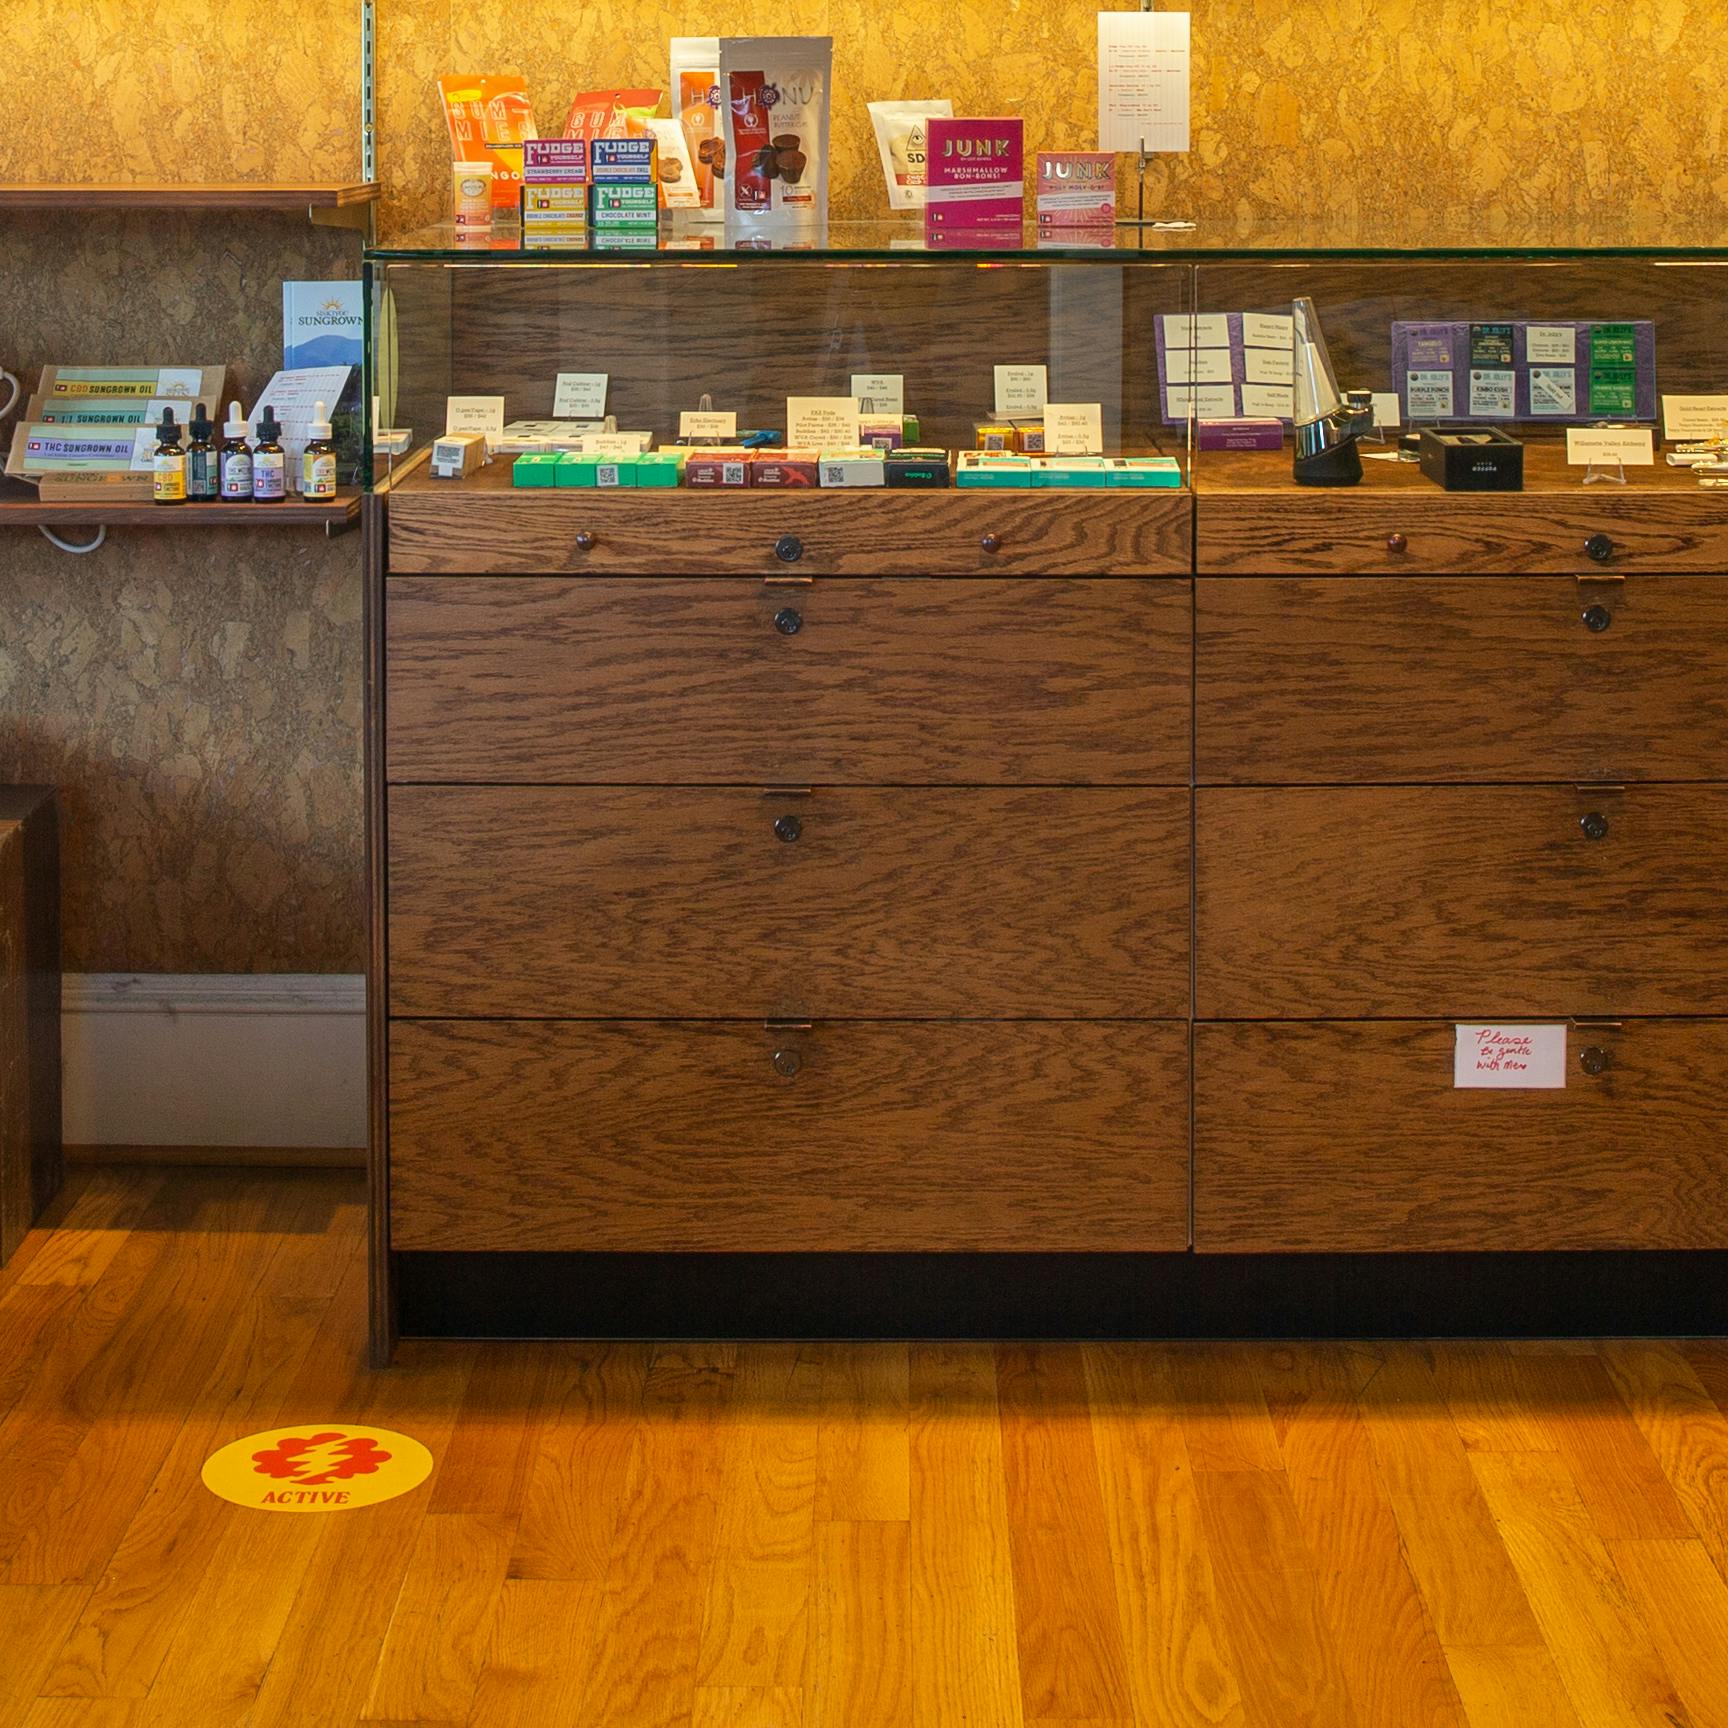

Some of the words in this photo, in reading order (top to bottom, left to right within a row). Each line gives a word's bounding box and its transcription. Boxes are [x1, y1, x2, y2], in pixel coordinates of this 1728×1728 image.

[527, 143, 584, 164] FUDGE
[594, 142, 650, 163] FUDGE
[944, 140, 1010, 157] JUNK
[1043, 161, 1110, 180] JUNK
[526, 188, 584, 209] FUDGE
[597, 188, 654, 209] FUDGE
[298, 316, 363, 325] SUNGROWN
[89, 385, 135, 393] SUNGROWN
[45, 443, 62, 451] THC
[63, 443, 112, 453] SUNGROWN
[115, 444, 128, 453] OIL
[1475, 1029, 1533, 1045] Please
[1498, 1046, 1532, 1060] gentle
[1477, 1057, 1500, 1071] with
[261, 1491, 351, 1504] ACTIVE
